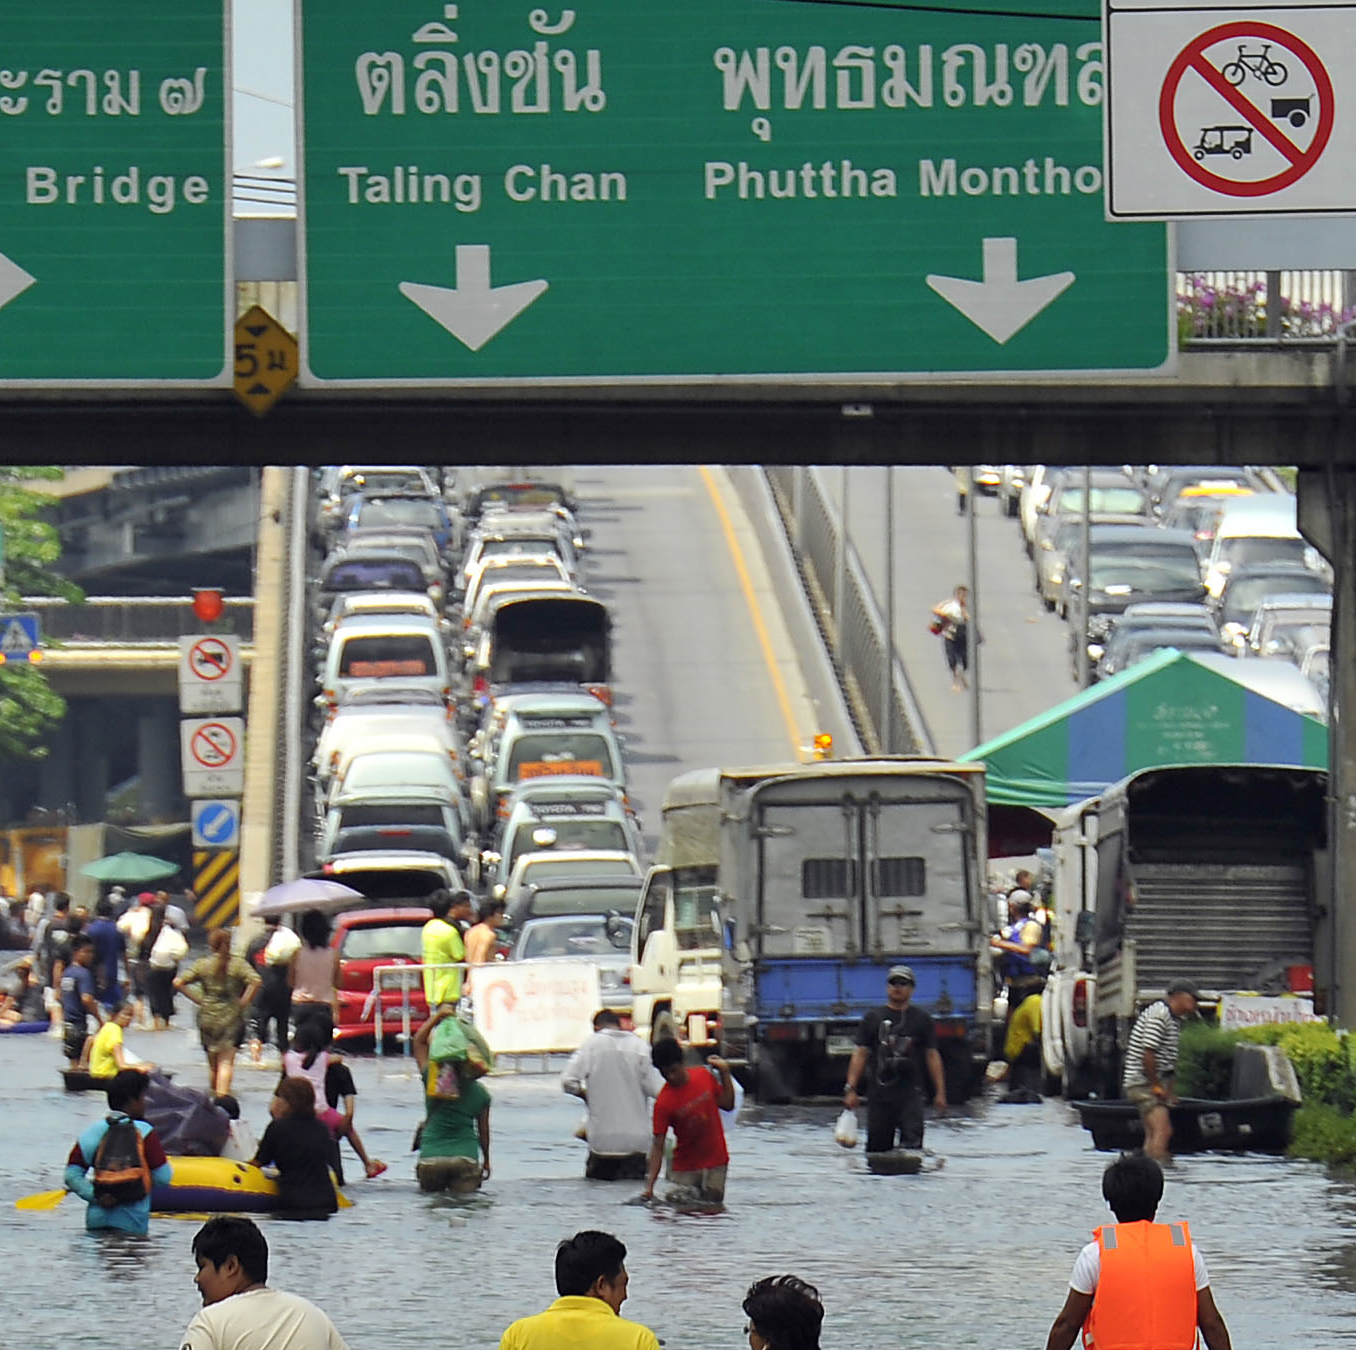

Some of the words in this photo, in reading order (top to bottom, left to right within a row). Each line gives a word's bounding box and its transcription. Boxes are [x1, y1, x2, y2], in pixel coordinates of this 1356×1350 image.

[357, 4, 606, 114] ตลิ่งชัน
[159, 67, 207, 115] ๗
[27, 165, 210, 214] Bridge
[338, 165, 482, 213] Taling
[504, 164, 627, 202] Chan
[705, 158, 897, 199] Phuttha
[234, 343, 258, 378] 5
